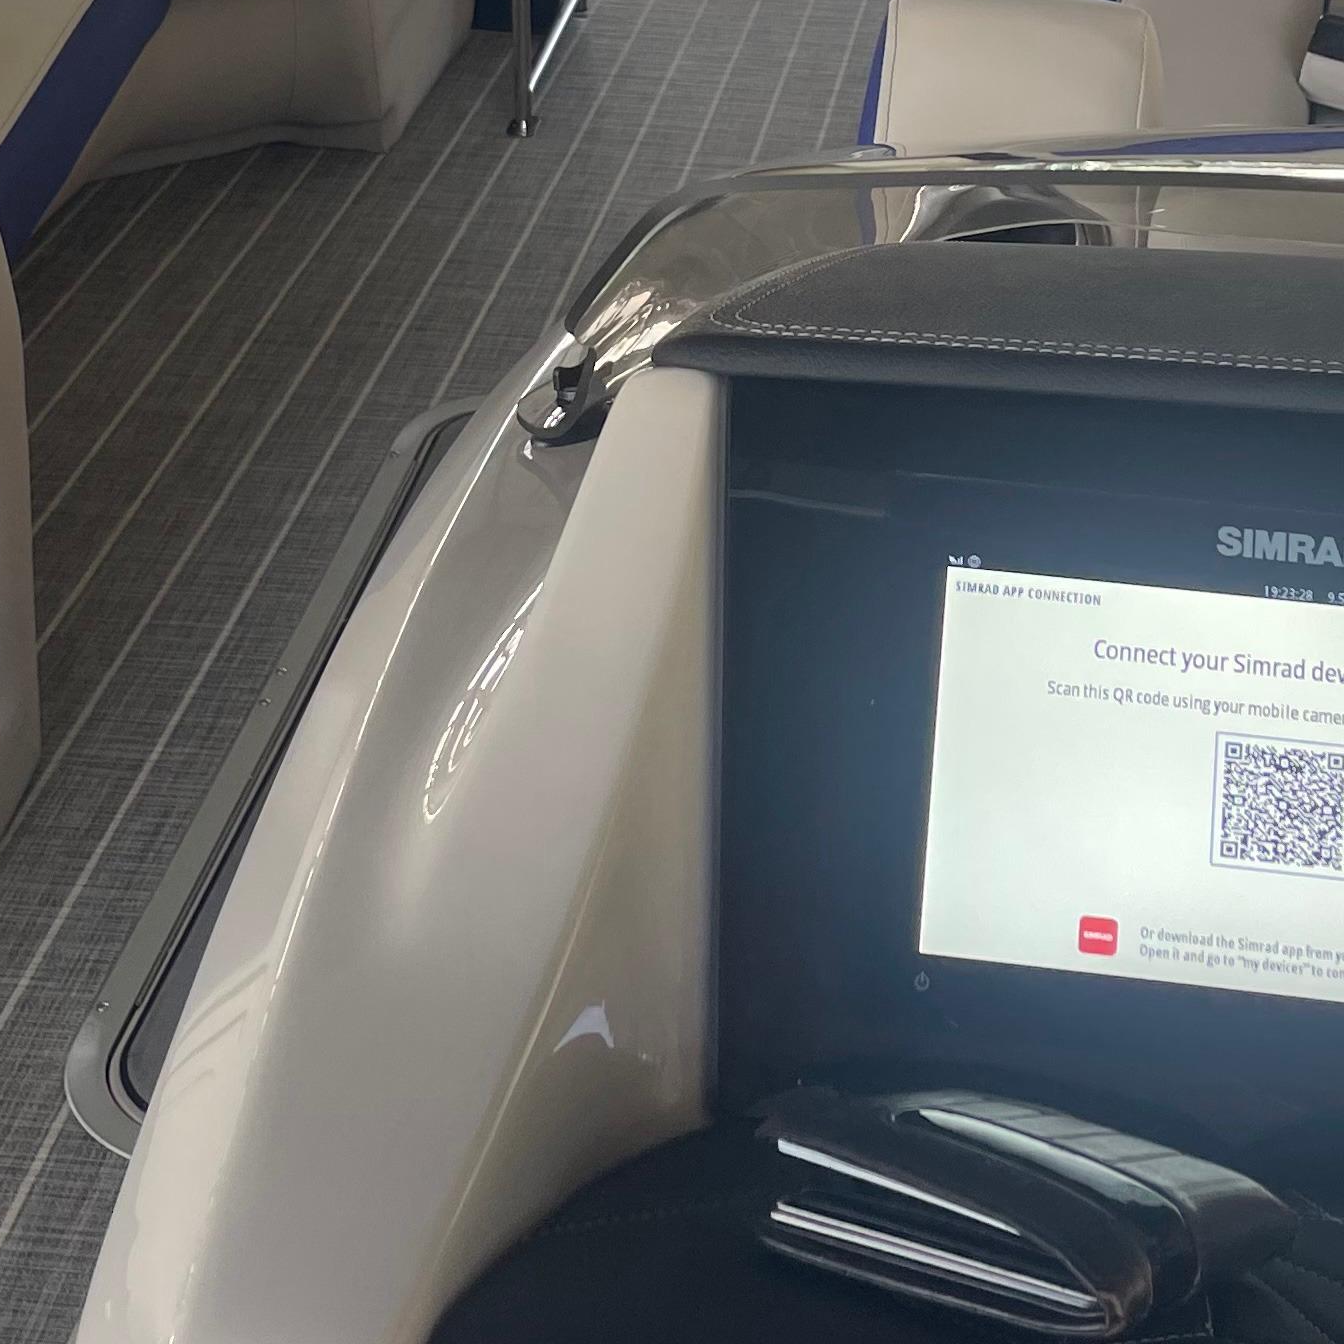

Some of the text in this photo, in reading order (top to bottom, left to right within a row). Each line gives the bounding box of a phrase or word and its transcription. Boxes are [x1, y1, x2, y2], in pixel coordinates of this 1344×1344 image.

[956, 580, 1101, 606] SIMRAD APP CONNECTION
[1264, 585, 1314, 601] 19:23:28
[1094, 639, 1177, 667] Connect
[1180, 650, 1229, 673] your
[1234, 654, 1305, 679] Simrad
[1047, 680, 1080, 698] Scan
[1083, 683, 1109, 700] this
[1113, 687, 1133, 705] QR
[1136, 691, 1170, 707] code
[1173, 694, 1211, 715] using
[1212, 700, 1245, 716] your
[1248, 703, 1299, 721] mobile
[1140, 925, 1155, 940] Or
[1157, 928, 1214, 946] download
[1216, 934, 1235, 949] the
[1238, 938, 1279, 954] Simrad
[1282, 945, 1303, 959] app
[1305, 945, 1333, 960] from
[1139, 944, 1171, 961] Open
[1172, 946, 1181, 959] it
[1183, 949, 1205, 963] and
[1206, 953, 1221, 967] go
[1223, 953, 1235, 966] to
[1311, 963, 1323, 977] to
